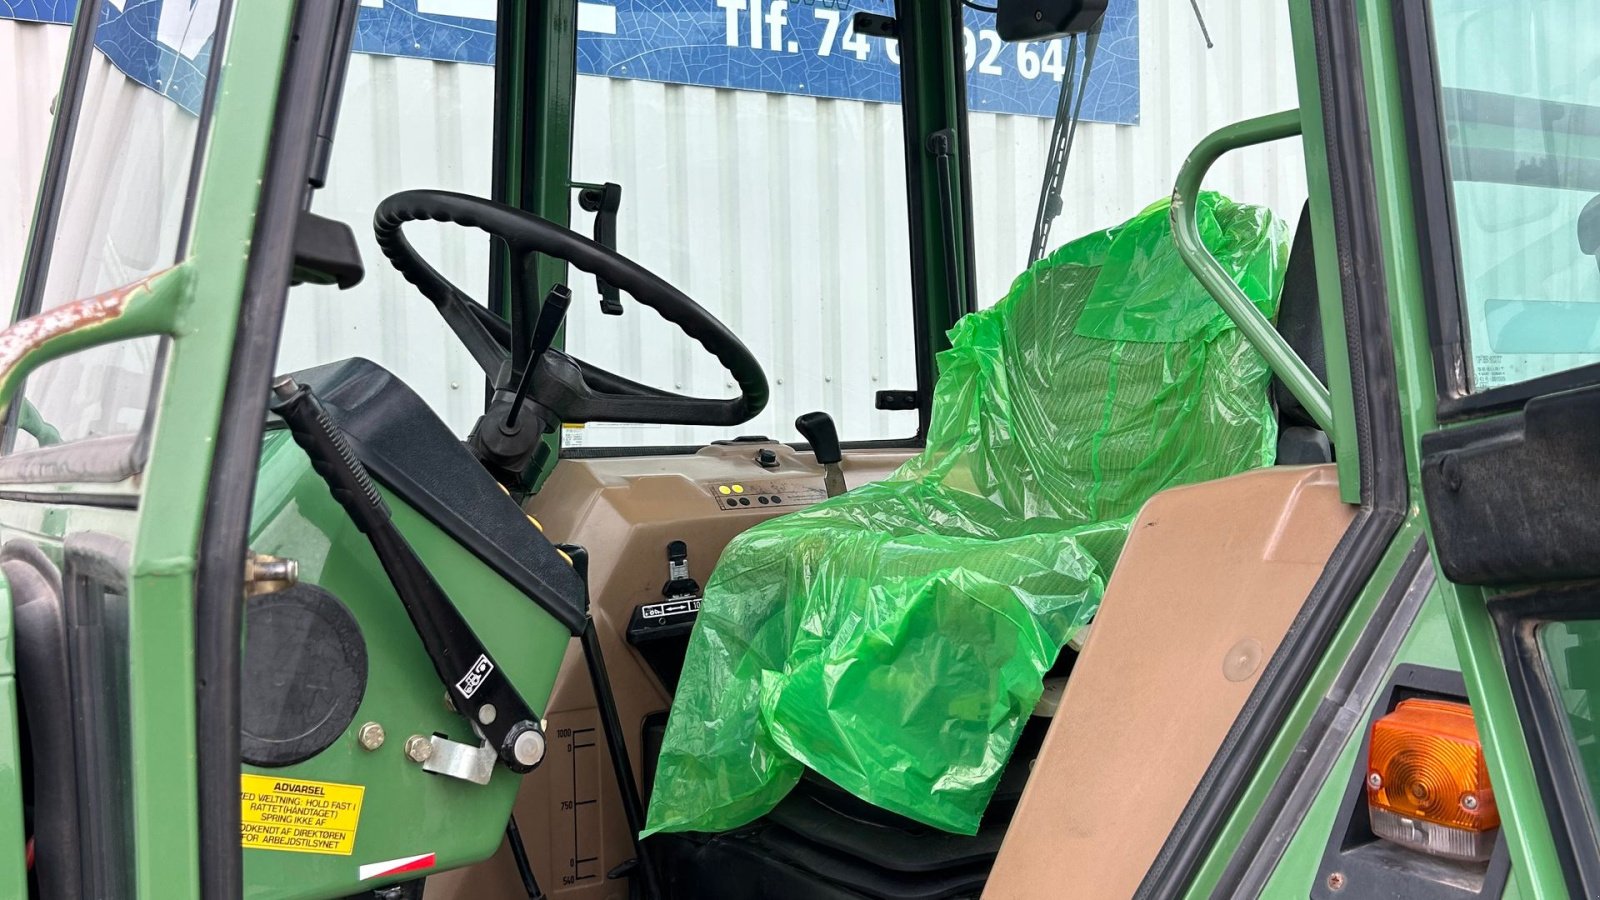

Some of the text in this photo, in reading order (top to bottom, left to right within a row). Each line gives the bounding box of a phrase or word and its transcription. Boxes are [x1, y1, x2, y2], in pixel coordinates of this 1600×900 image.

[716, 0, 799, 53] Tlf.
[814, 8, 871, 60] 74
[1016, 38, 1066, 82] 64
[556, 728, 572, 738] 1000
[274, 782, 325, 796] ADVARSEL
[306, 798, 329, 809] HOLD
[331, 801, 352, 811] FAST
[352, 803, 357, 811] I
[560, 801, 573, 811] 750
[261, 812, 327, 826] SPRING IKKE AF
[240, 823, 347, 841] ODKENDT AF DIREKTØREN
[240, 833, 340, 849] FOR ARBEJDSTILSYNET
[562, 875, 575, 886] 540
